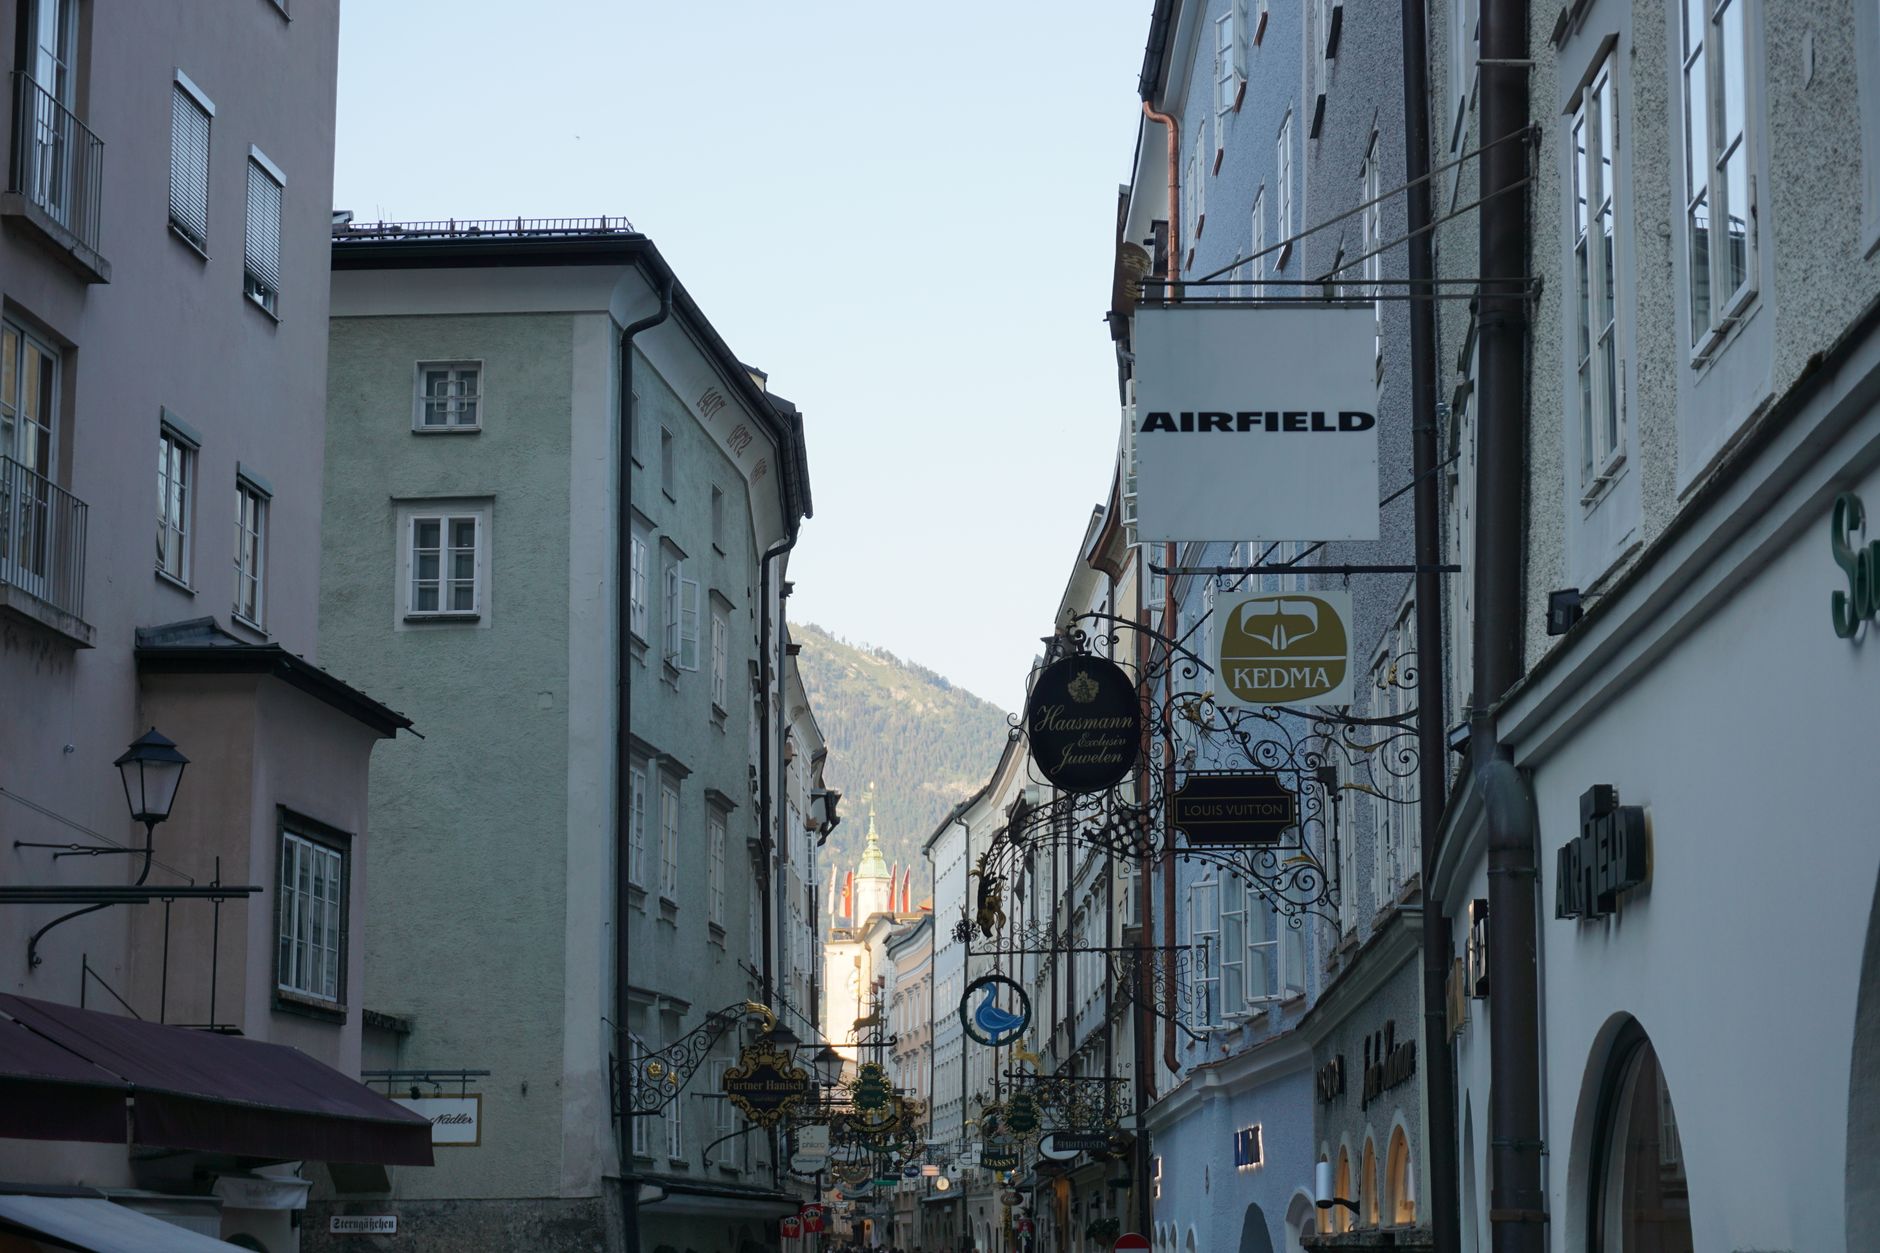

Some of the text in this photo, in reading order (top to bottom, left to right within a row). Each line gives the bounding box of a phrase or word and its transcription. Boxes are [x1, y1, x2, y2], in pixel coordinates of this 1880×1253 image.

[1140, 411, 1376, 432] AIRFIELD
[1233, 667, 1331, 690] KEDMA
[1034, 704, 1133, 732] Haasmann
[1077, 732, 1127, 748] Exclusiv
[1050, 743, 1122, 775] Juwelen
[1184, 803, 1284, 817] LOUIS VUITTON
[727, 1079, 804, 1091] Furtner Hanisch
[430, 1113, 474, 1125] Nadler
[983, 1157, 1016, 1168] STASSNY
